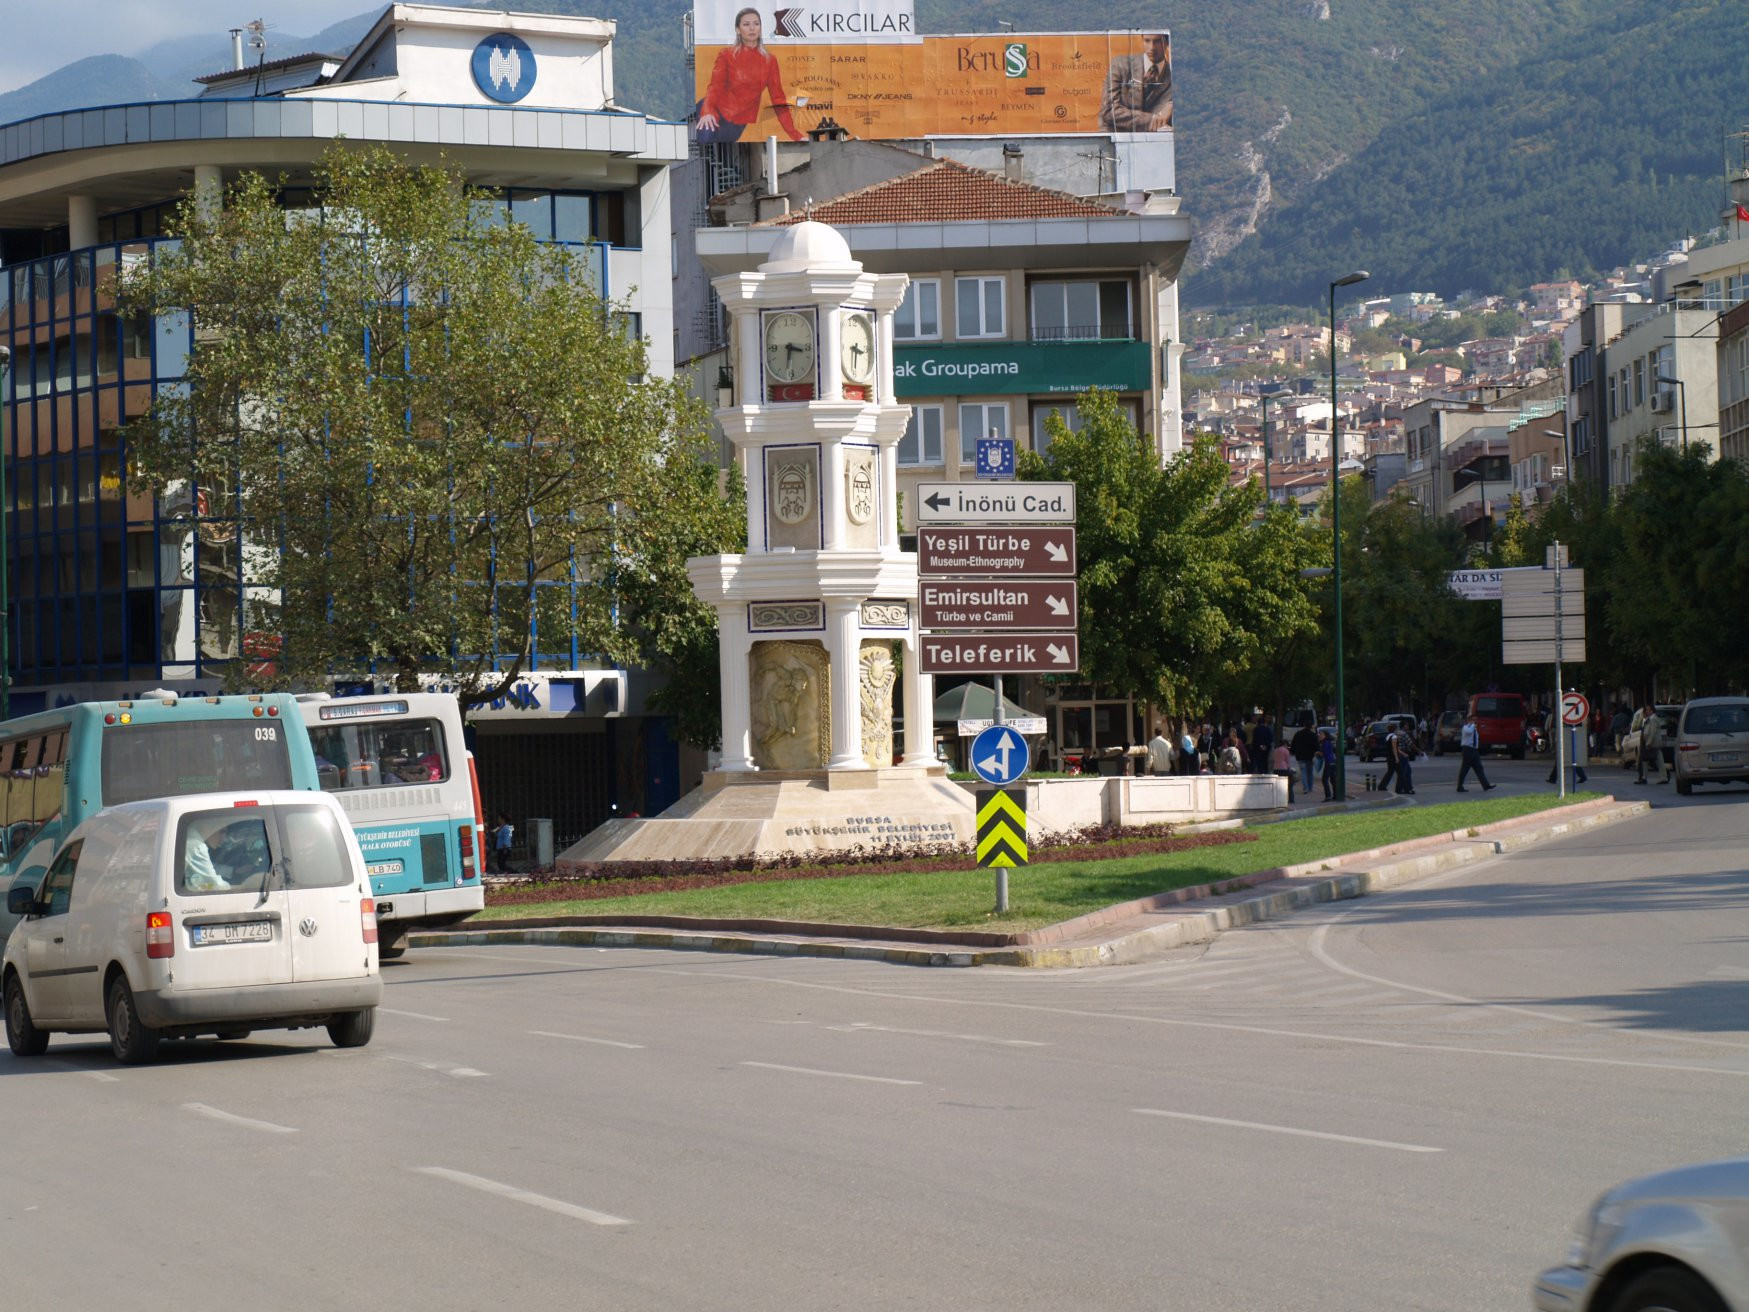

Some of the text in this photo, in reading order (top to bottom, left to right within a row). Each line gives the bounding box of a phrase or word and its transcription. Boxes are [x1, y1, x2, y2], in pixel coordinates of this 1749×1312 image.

[811, 13, 911, 32] KIRCILAR
[1063, 88, 1091, 97] bugatti
[807, 101, 833, 111] mavi
[1001, 103, 1035, 111] BEYMEN
[921, 360, 1019, 378] Groupama
[958, 491, 1067, 512] İnönü Cad.
[925, 535, 1031, 554] Yeşil Türbe
[930, 556, 1025, 568] Museum-Ethnography
[925, 588, 1029, 606] Emirsultan
[936, 611, 1014, 622] Türbe ve Camii
[926, 644, 1036, 663] Teleferik
[255, 727, 276, 741] 039
[846, 816, 892, 825] BURSA
[388, 827, 420, 838] BELEDİYESİ
[785, 821, 953, 837] BÜYÜKŞEHİR BELEDİYESİ
[869, 832, 956, 843] 11 EYLÜL 2007
[362, 838, 412, 851] HALK OTOBÜSÜ
[386, 864, 401, 873] 740
[201, 926, 215, 940] 34
